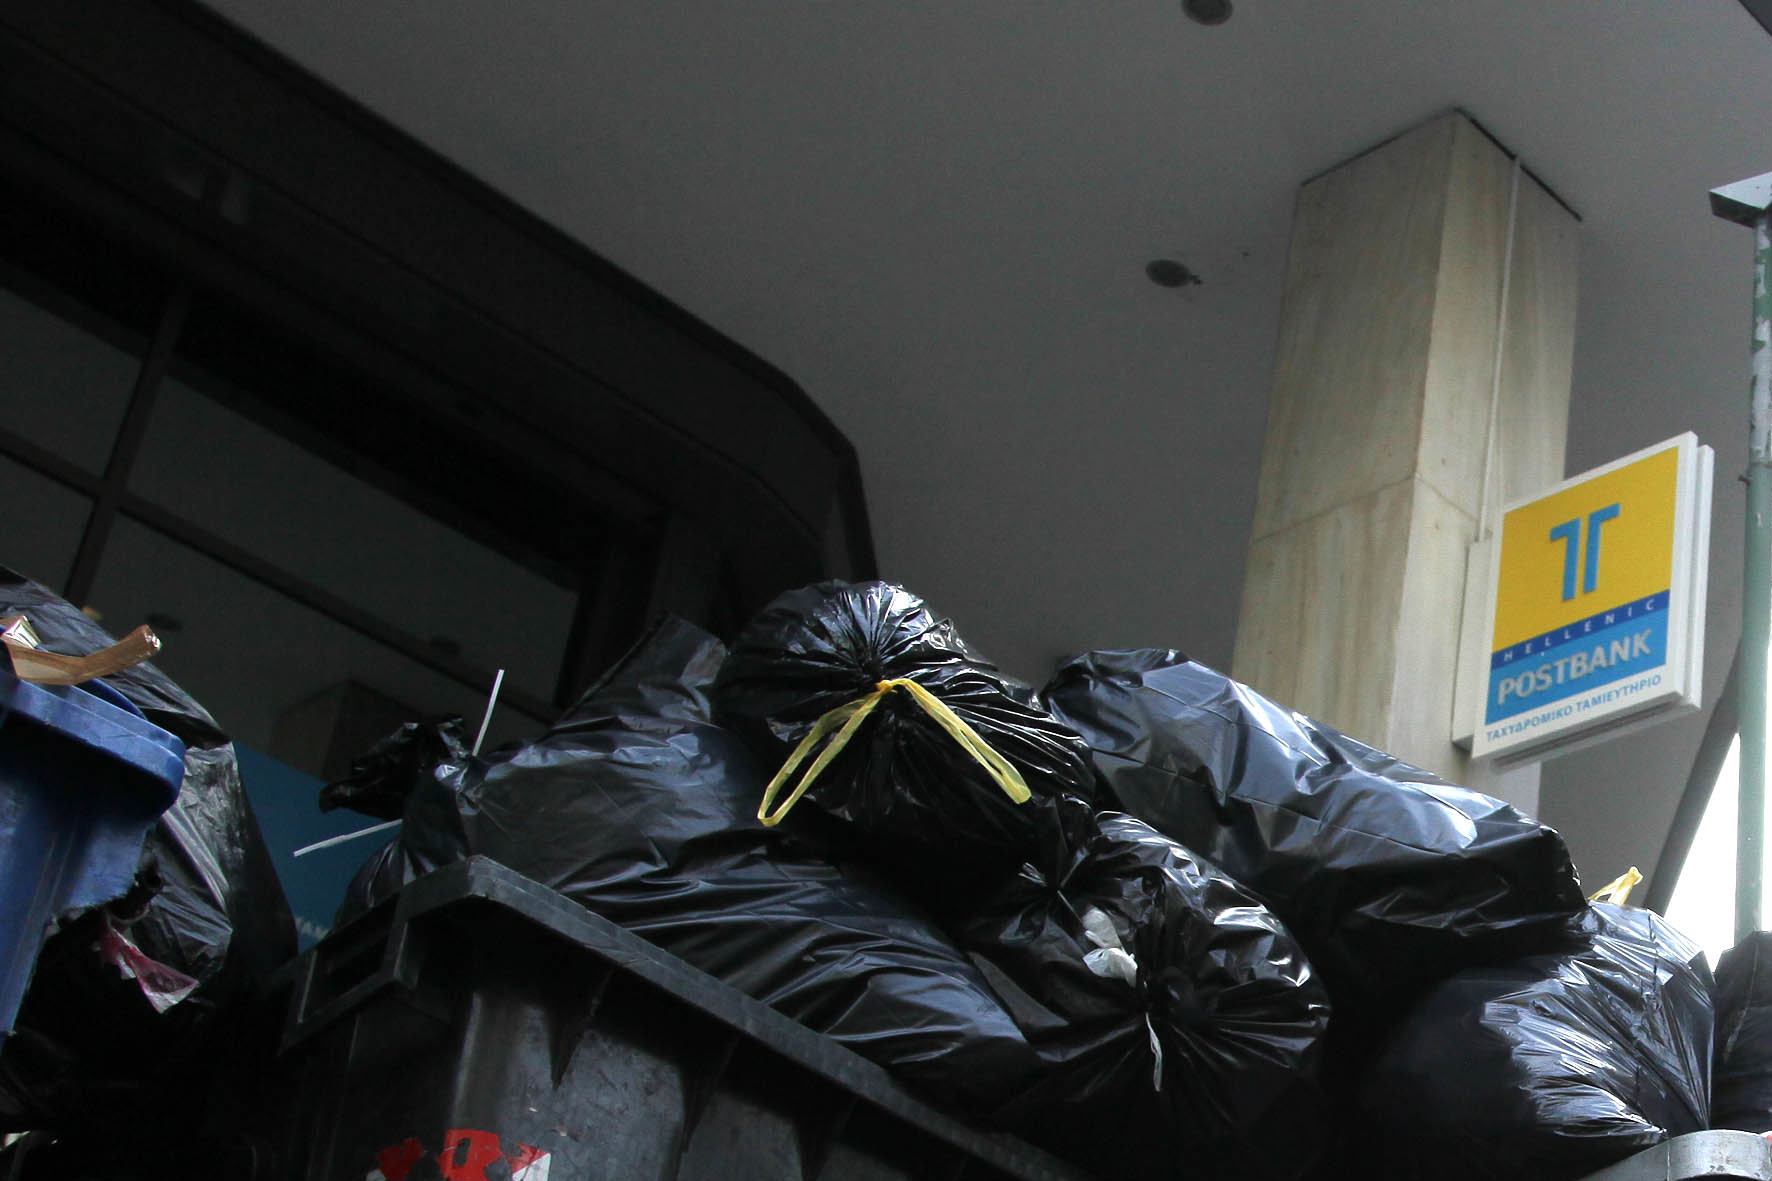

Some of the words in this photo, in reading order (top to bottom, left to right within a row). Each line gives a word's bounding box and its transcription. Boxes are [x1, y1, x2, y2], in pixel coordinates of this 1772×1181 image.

[1503, 599, 1655, 662] HELLENIC
[1497, 629, 1653, 704] POSTBANK
[1486, 705, 1573, 742] ΤΑΧΥΔΡΟΜΙΚΟ
[1576, 674, 1662, 712] ΤΑΜΙΕΥΤΗΡΙΟ
